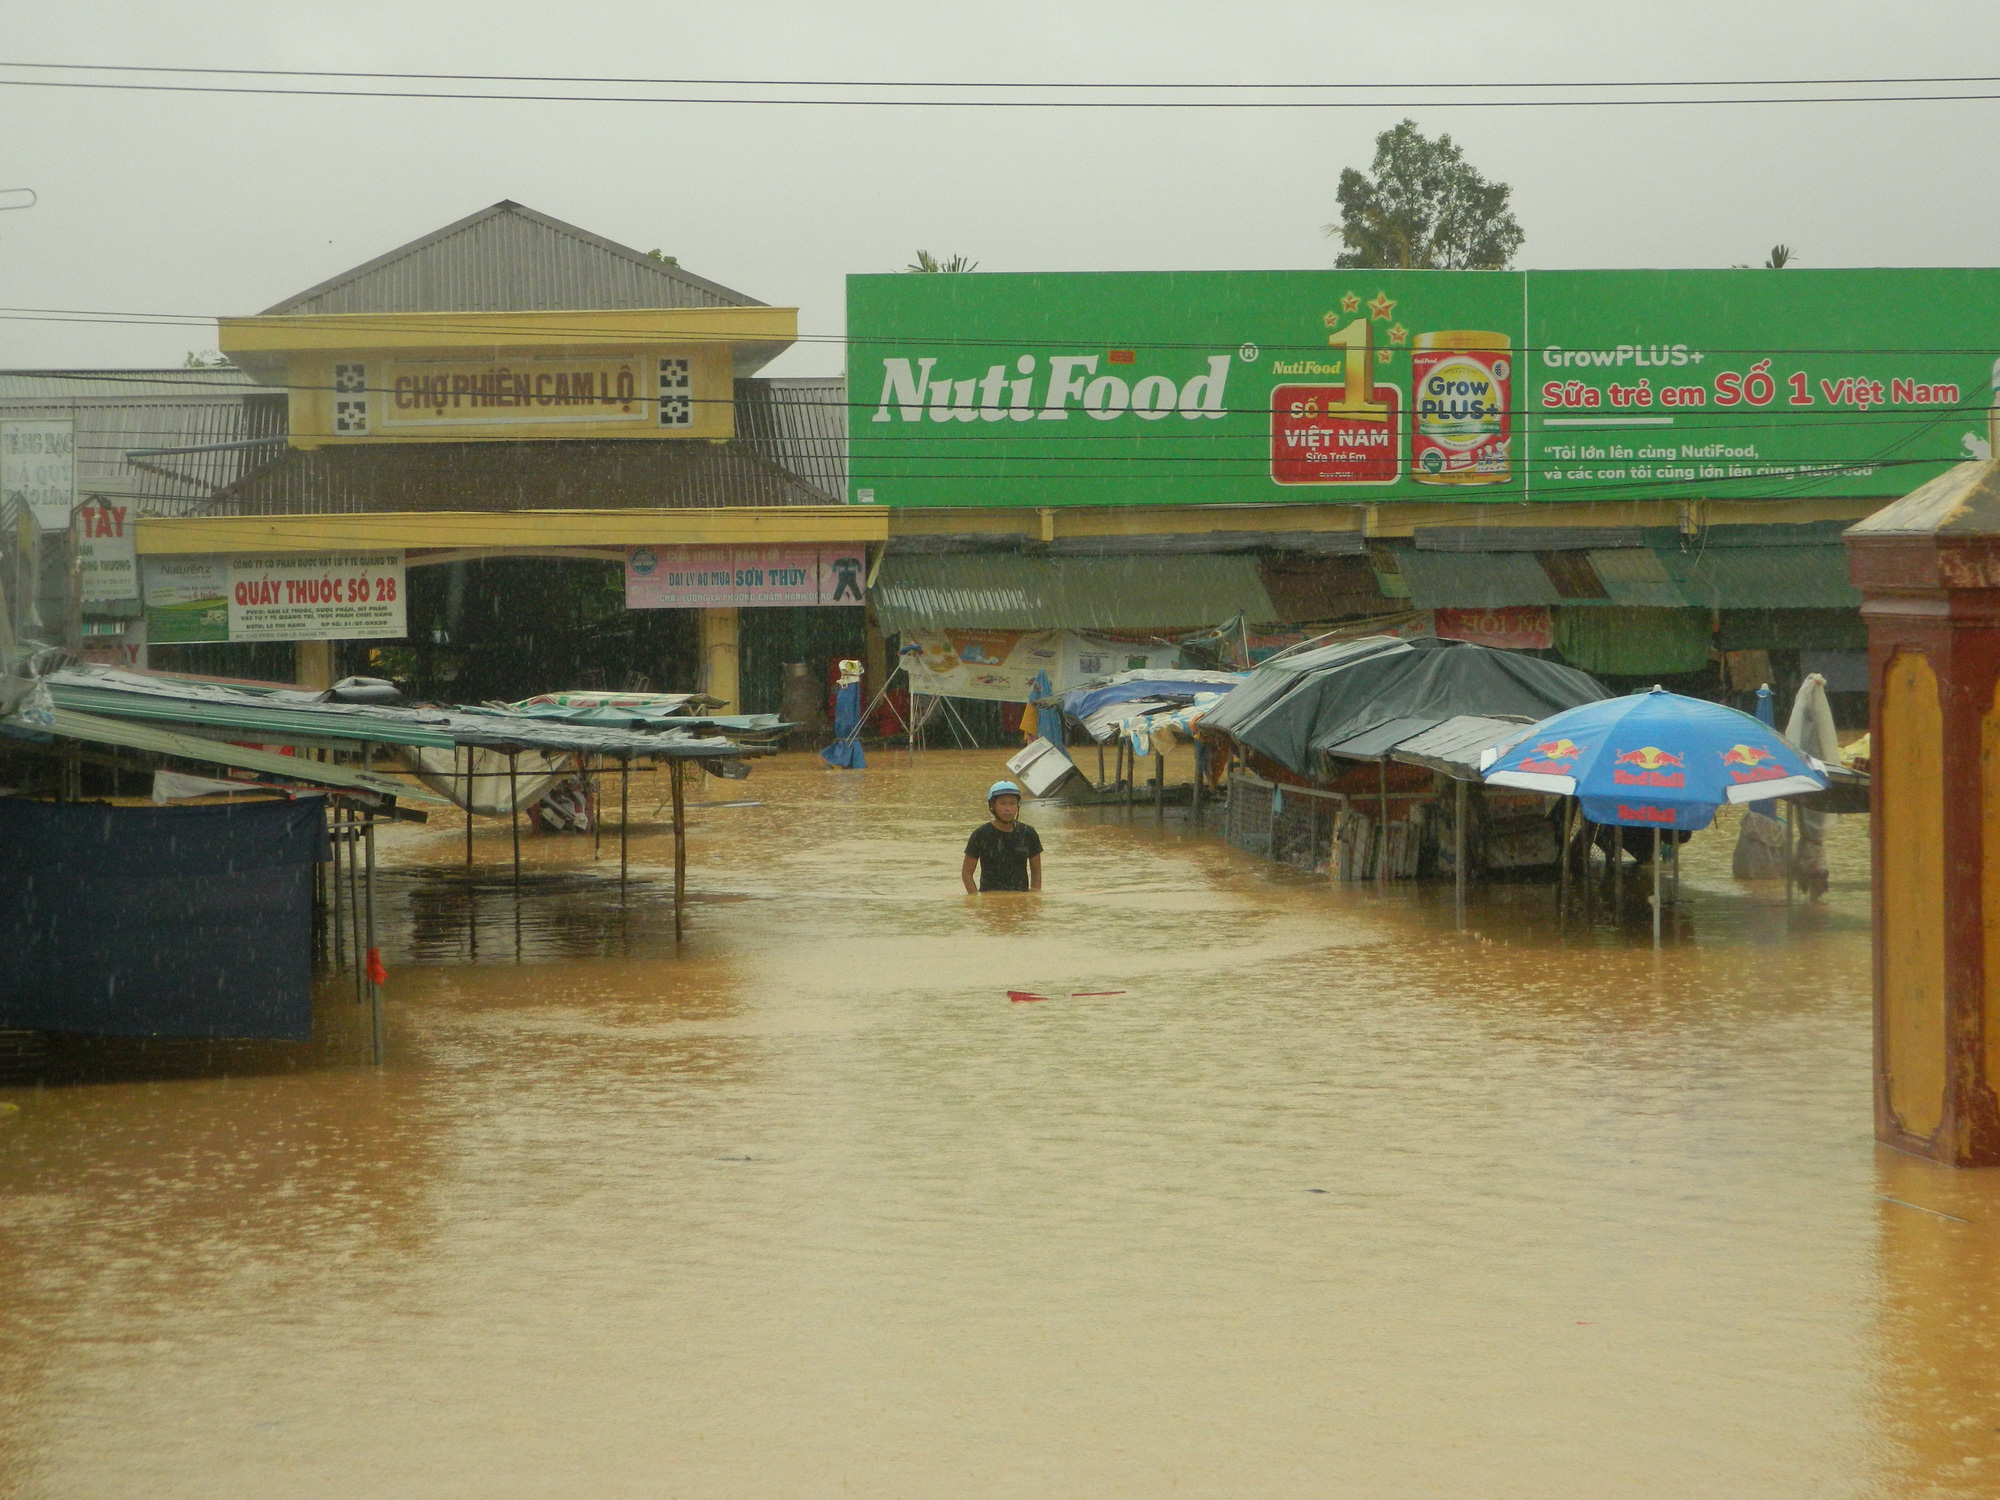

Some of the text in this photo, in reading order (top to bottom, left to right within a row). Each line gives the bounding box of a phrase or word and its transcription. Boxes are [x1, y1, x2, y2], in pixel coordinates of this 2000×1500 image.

[1543, 345, 1704, 367] GrowPLUS+
[1272, 361, 1341, 374] NutiFood
[1328, 317, 1388, 423] 1
[395, 374, 449, 416] CHỢ
[536, 371, 595, 407] CAM
[601, 364, 635, 412] LỘ
[1428, 376, 1489, 396] Grow
[1543, 358, 1960, 410] Sữa trẻ em SỐ 1 Việt Nam
[1421, 400, 1498, 419] PLUS+
[1284, 425, 1388, 451] VIỆT NAM
[1581, 445, 1605, 459] lớn
[1610, 445, 1633, 459] lên
[1638, 445, 1676, 461] cùng
[1681, 445, 1759, 460] NutiFood,
[1544, 466, 1561, 479] và
[1567, 466, 1590, 479] các
[1597, 468, 1625, 479] con
[1629, 466, 1651, 478] tôi
[1656, 465, 1694, 480] cũng
[735, 566, 764, 587] SƠN
[768, 562, 808, 586] THỦY
[235, 570, 397, 606] QUẦY THUỐC SỐ 28
[1613, 769, 1685, 788] Red Bull
[1618, 804, 1676, 823] Red Bull
